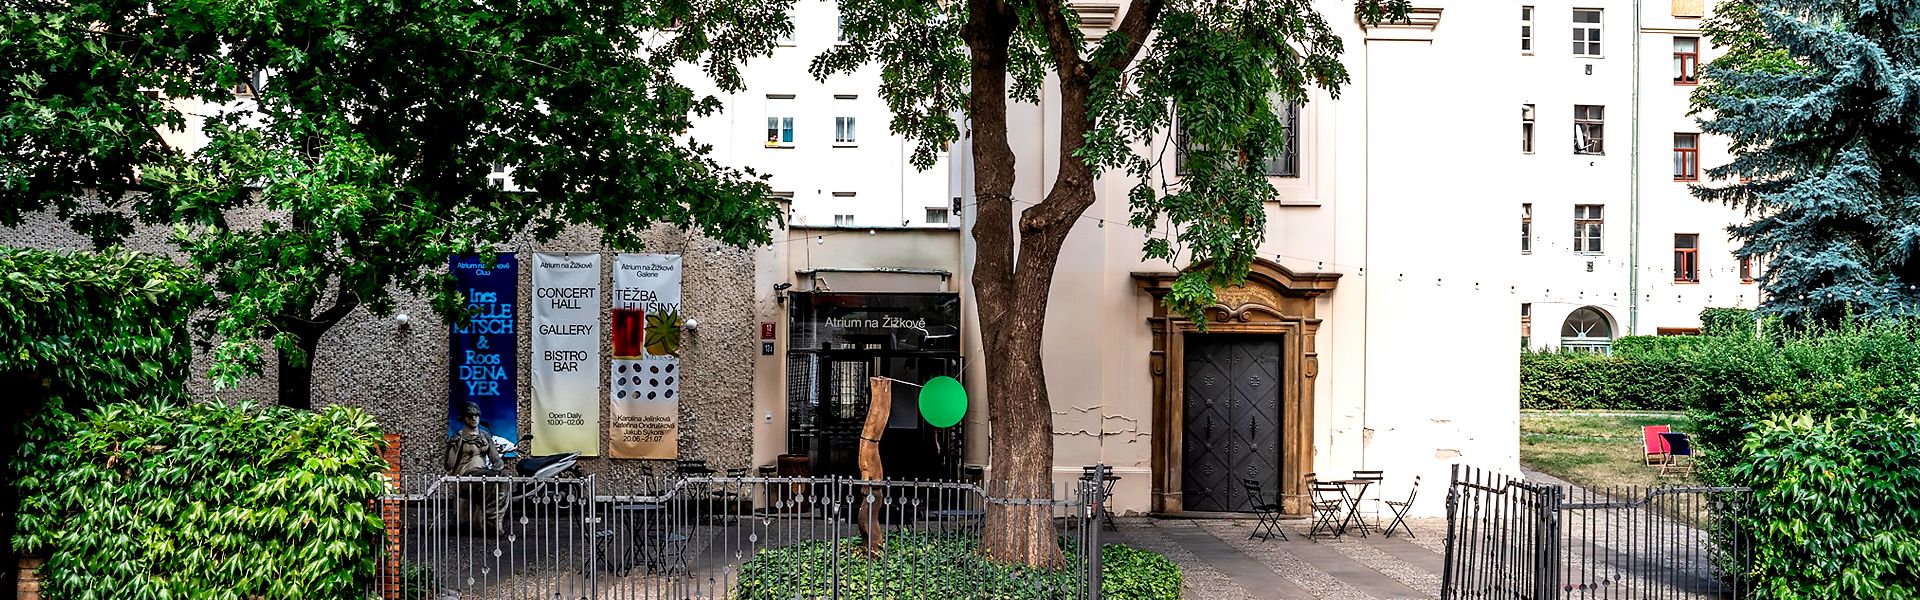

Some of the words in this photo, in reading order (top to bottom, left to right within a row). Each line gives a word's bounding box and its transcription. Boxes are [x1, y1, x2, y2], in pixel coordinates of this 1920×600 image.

[570, 261, 593, 269] Žižkově
[651, 262, 674, 271] Žižkově
[469, 288, 497, 303] Ines
[537, 288, 596, 298] CONCERT
[615, 287, 658, 301] TĚŽBA
[467, 304, 512, 318] OLLE
[552, 299, 581, 309] HALL
[824, 317, 862, 328] Atrium
[864, 320, 879, 328] na
[882, 314, 926, 328] Žižkově
[539, 324, 594, 335] GALLERY
[476, 335, 490, 349] &
[465, 350, 500, 364] Roos
[544, 350, 588, 361] BISTRO
[459, 366, 508, 380] DENA
[554, 362, 578, 372] BAR
[466, 380, 500, 396] YER
